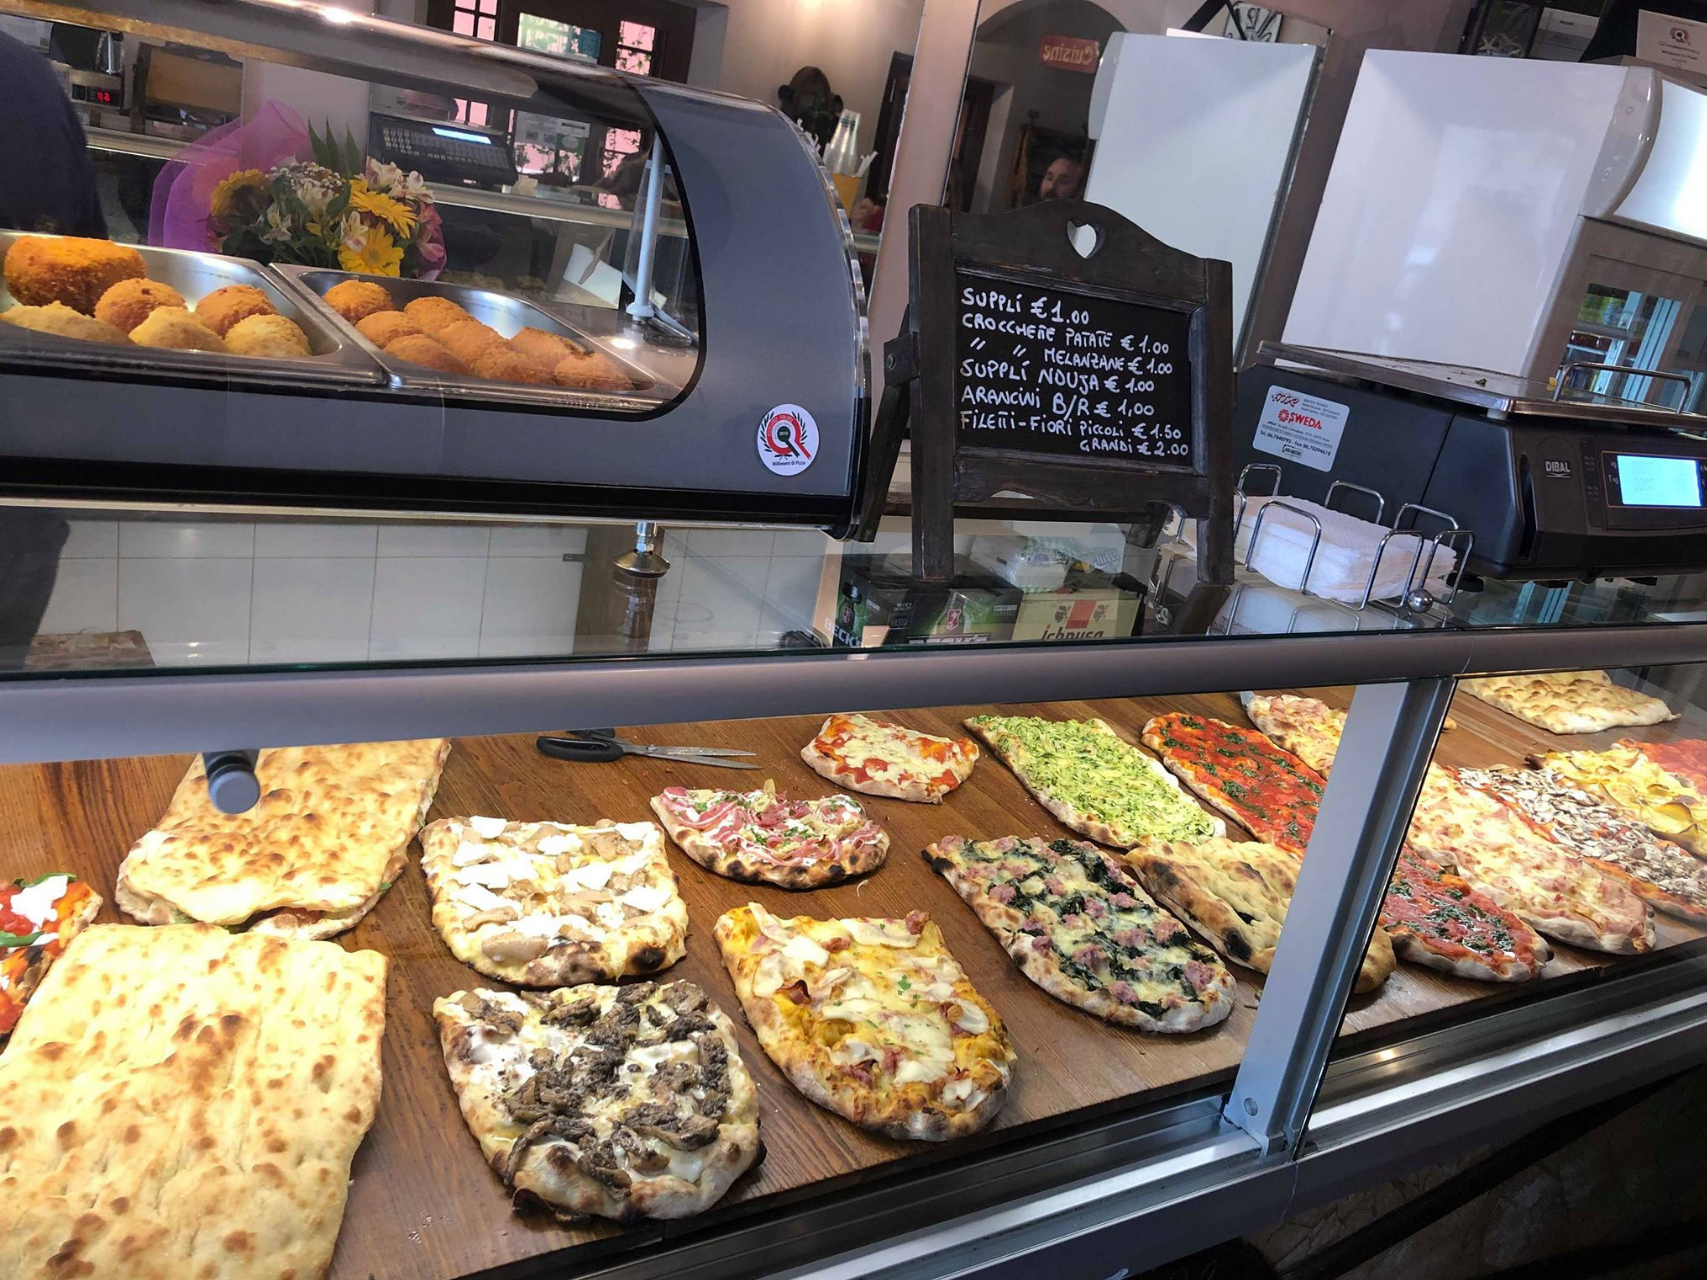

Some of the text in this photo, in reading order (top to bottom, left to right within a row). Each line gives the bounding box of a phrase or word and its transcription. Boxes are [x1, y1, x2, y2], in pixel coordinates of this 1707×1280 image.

[1065, 328, 1113, 348] PATATE
[1044, 347, 1125, 371] MELANZANE
[1289, 412, 1322, 430] SWEDA
[1545, 460, 1571, 473] DIBAL
